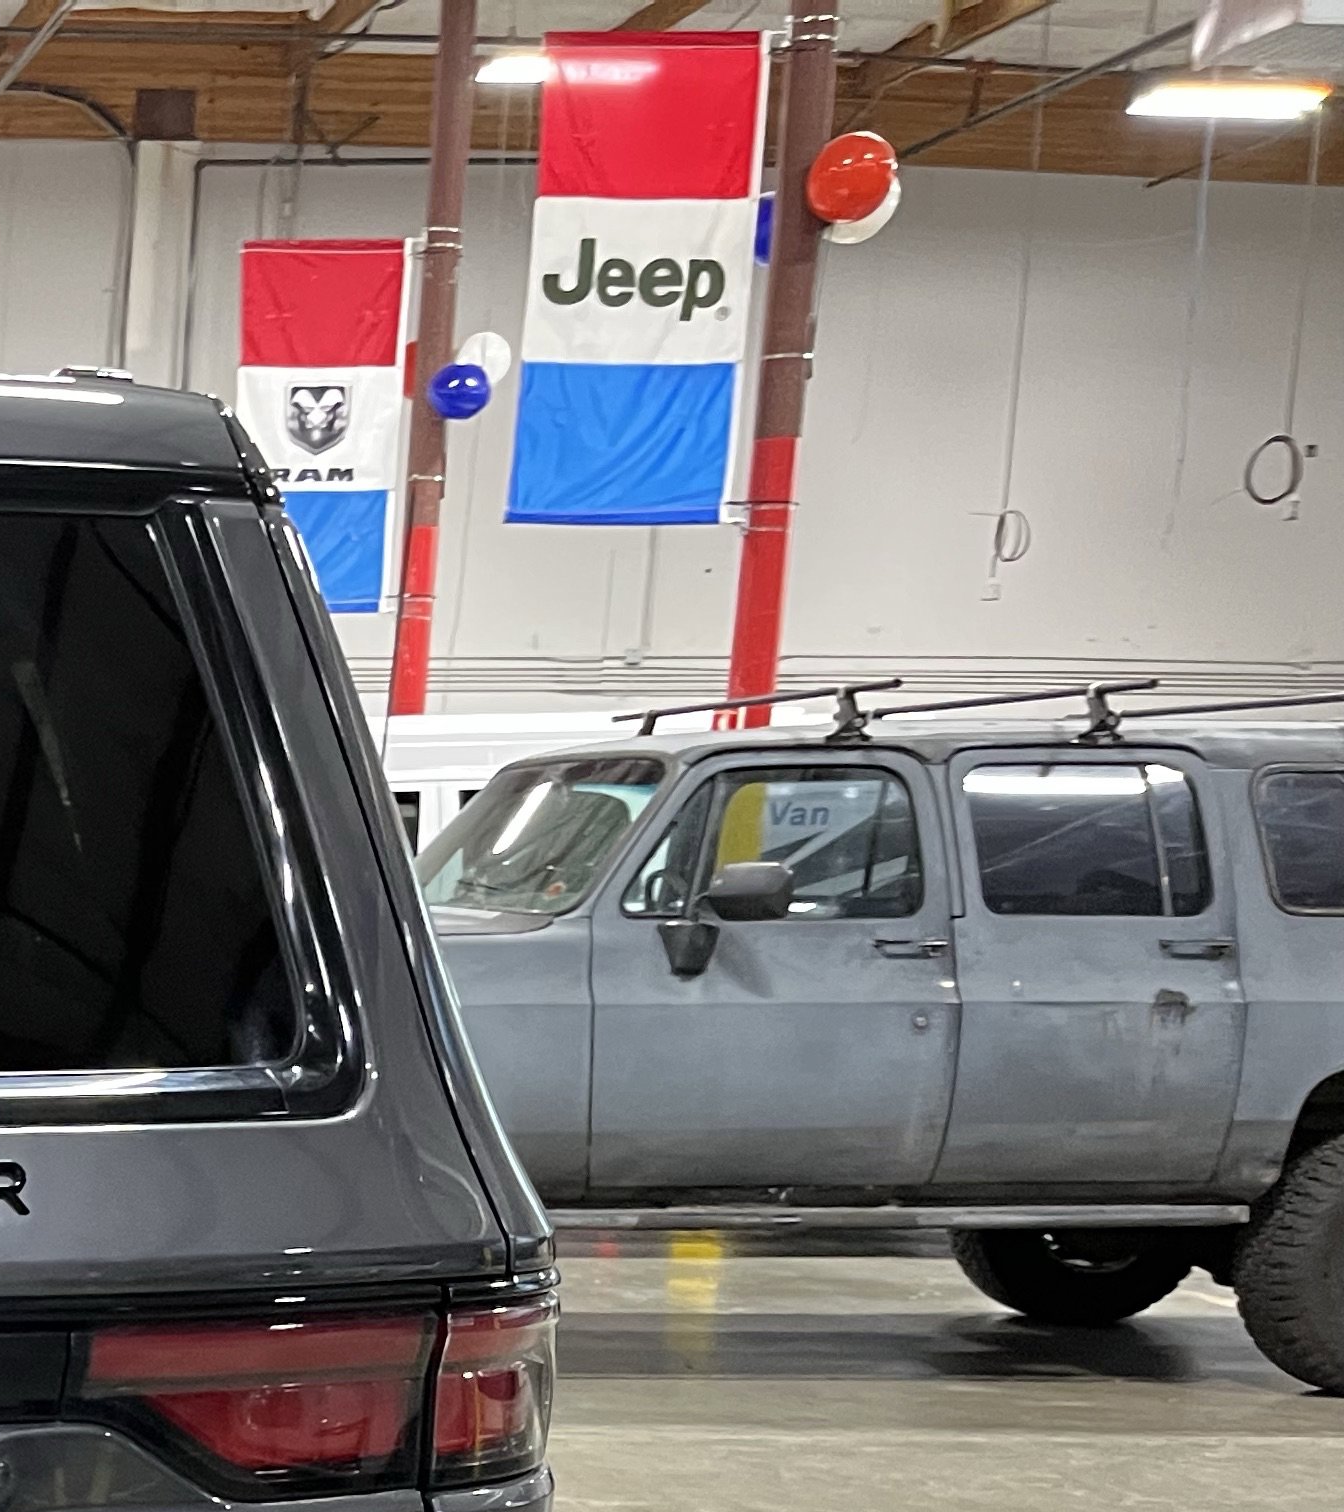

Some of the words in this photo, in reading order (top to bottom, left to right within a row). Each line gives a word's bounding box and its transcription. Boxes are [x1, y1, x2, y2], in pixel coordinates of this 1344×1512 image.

[542, 238, 725, 321] Jeep
[271, 468, 354, 482] RAM
[769, 802, 830, 826] Van
